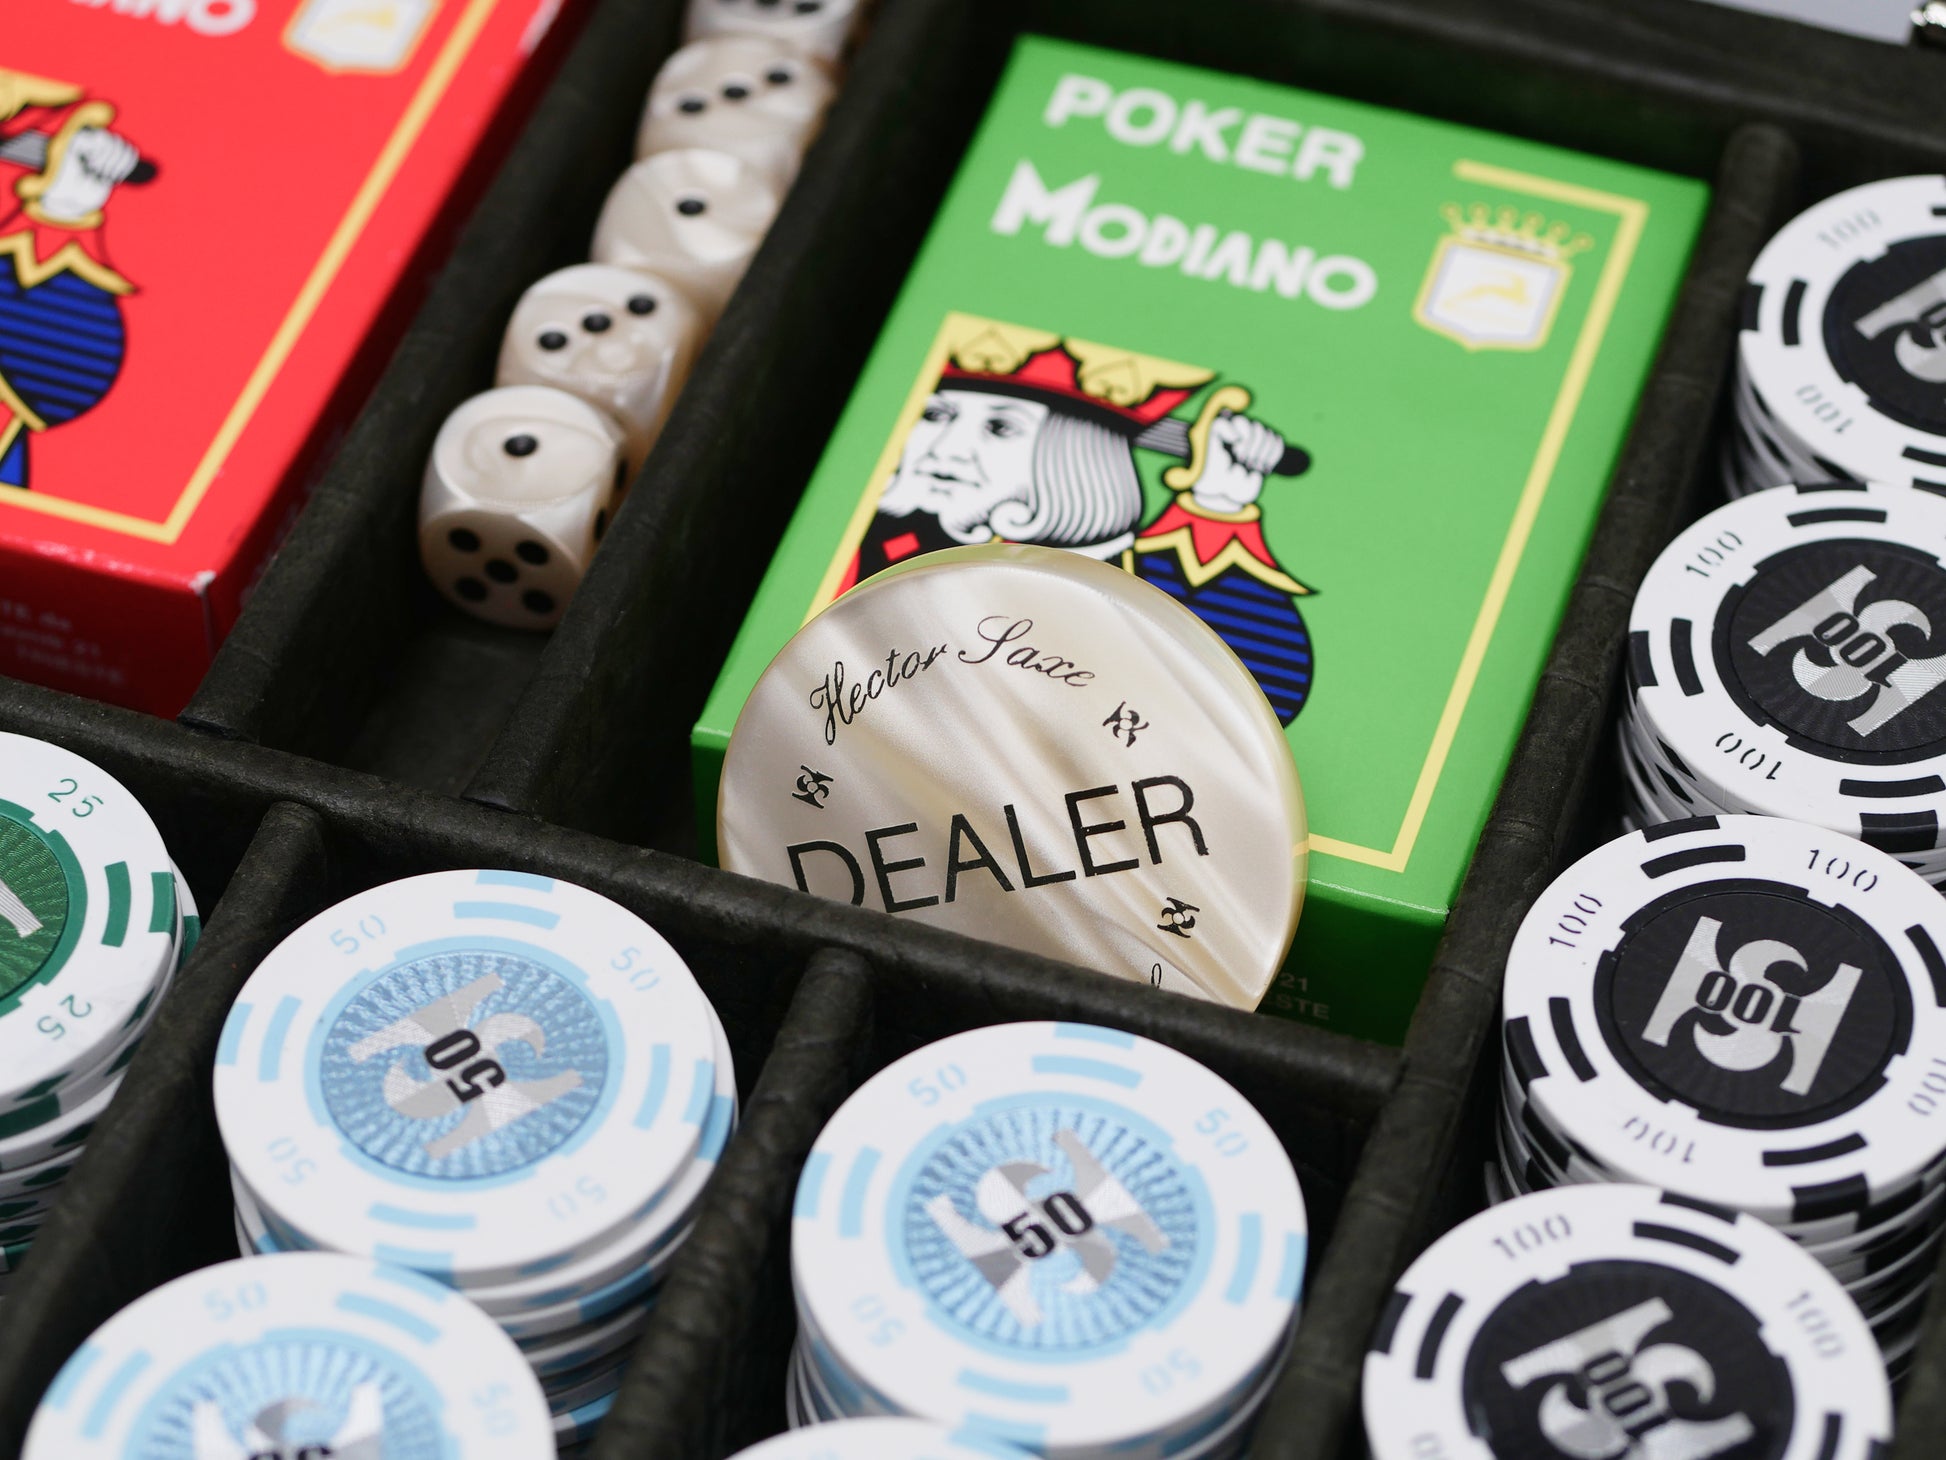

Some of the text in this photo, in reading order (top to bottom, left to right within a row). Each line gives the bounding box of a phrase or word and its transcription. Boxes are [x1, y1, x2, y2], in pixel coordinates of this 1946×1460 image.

[1043, 74, 1364, 189] POKER
[990, 158, 1378, 310] MODIANO
[1816, 209, 1882, 250] 100
[1796, 383, 1855, 437] 100
[1684, 530, 1744, 578] 100
[1812, 611, 1909, 689] 100
[809, 615, 1096, 745] Hector Saxe
[1715, 732, 1783, 782] 100
[46, 778, 104, 818] 25
[787, 774, 1209, 914] DEALER
[1808, 849, 1880, 893] 100
[330, 915, 386, 954] 50
[1548, 893, 1603, 949] 100
[611, 947, 660, 991] 50
[1278, 972, 1308, 992] 21
[35, 993, 94, 1042] 25
[1695, 970, 1801, 1034] 100
[425, 1029, 506, 1104] 50
[908, 1064, 966, 1106] 50
[1195, 1109, 1248, 1156] 50
[1620, 1115, 1696, 1165] 100
[267, 1136, 316, 1186] 50
[1002, 1191, 1094, 1259] 50
[1490, 1213, 1573, 1261] 100
[204, 1281, 268, 1321] 50
[1785, 1289, 1846, 1360] 100
[1582, 1349, 1672, 1443] 100
